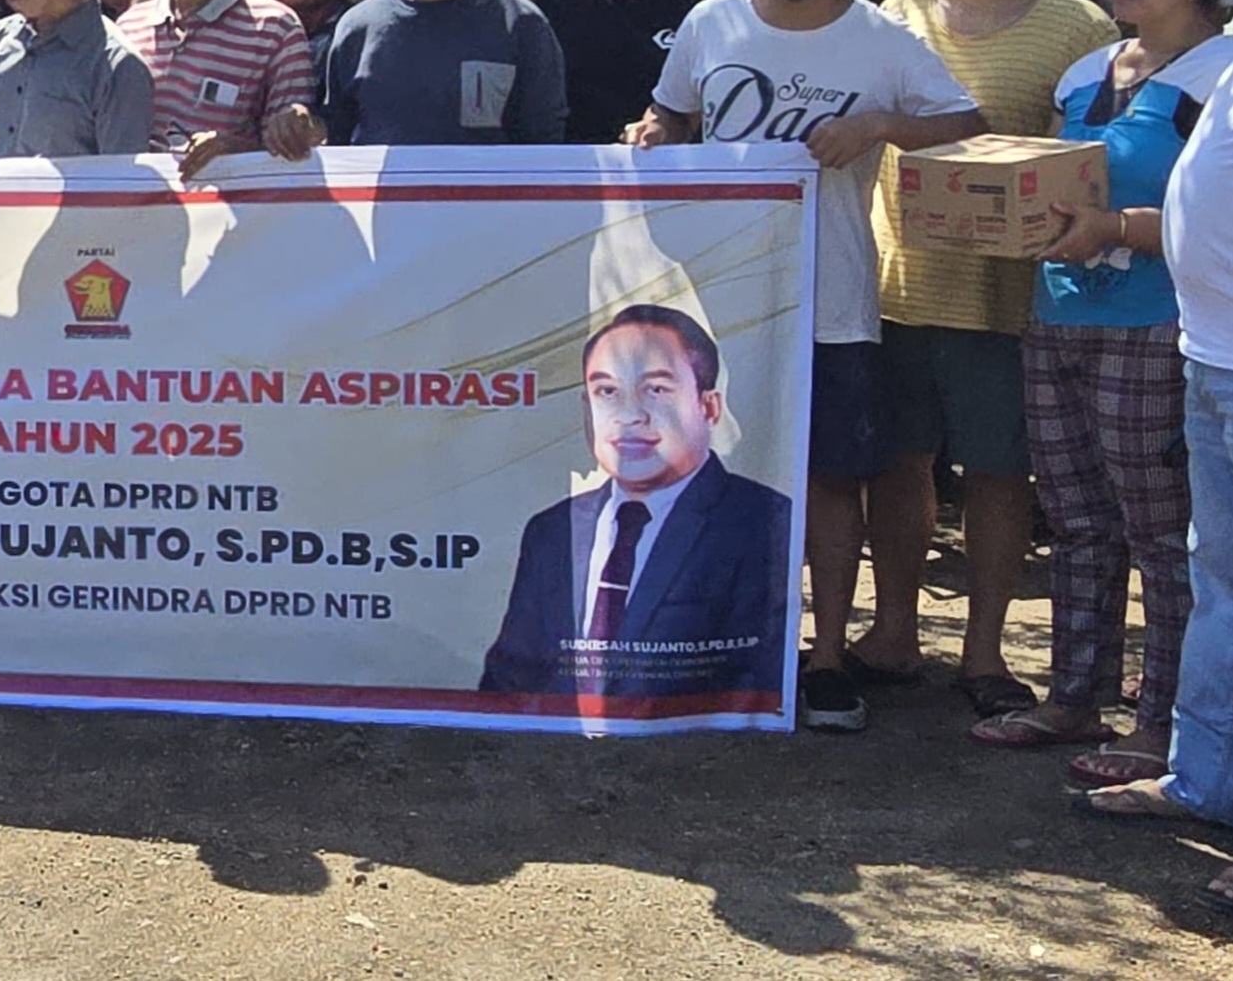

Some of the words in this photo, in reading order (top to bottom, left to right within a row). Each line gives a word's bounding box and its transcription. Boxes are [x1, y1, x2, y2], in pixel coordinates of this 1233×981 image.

[700, 63, 862, 143] Dad
[777, 72, 846, 106] Super
[76, 247, 116, 257] PARTAI
[47, 368, 285, 405] BANTUAN
[298, 371, 537, 407] ASPIRASI
[131, 422, 244, 458] 2025
[103, 482, 199, 511] DPRD
[208, 485, 279, 512] NTB
[47, 584, 216, 614] GERINDRA
[224, 589, 316, 617] DPRD
[324, 593, 392, 620] NTB
[559, 639, 630, 652] SUDIRSAH
